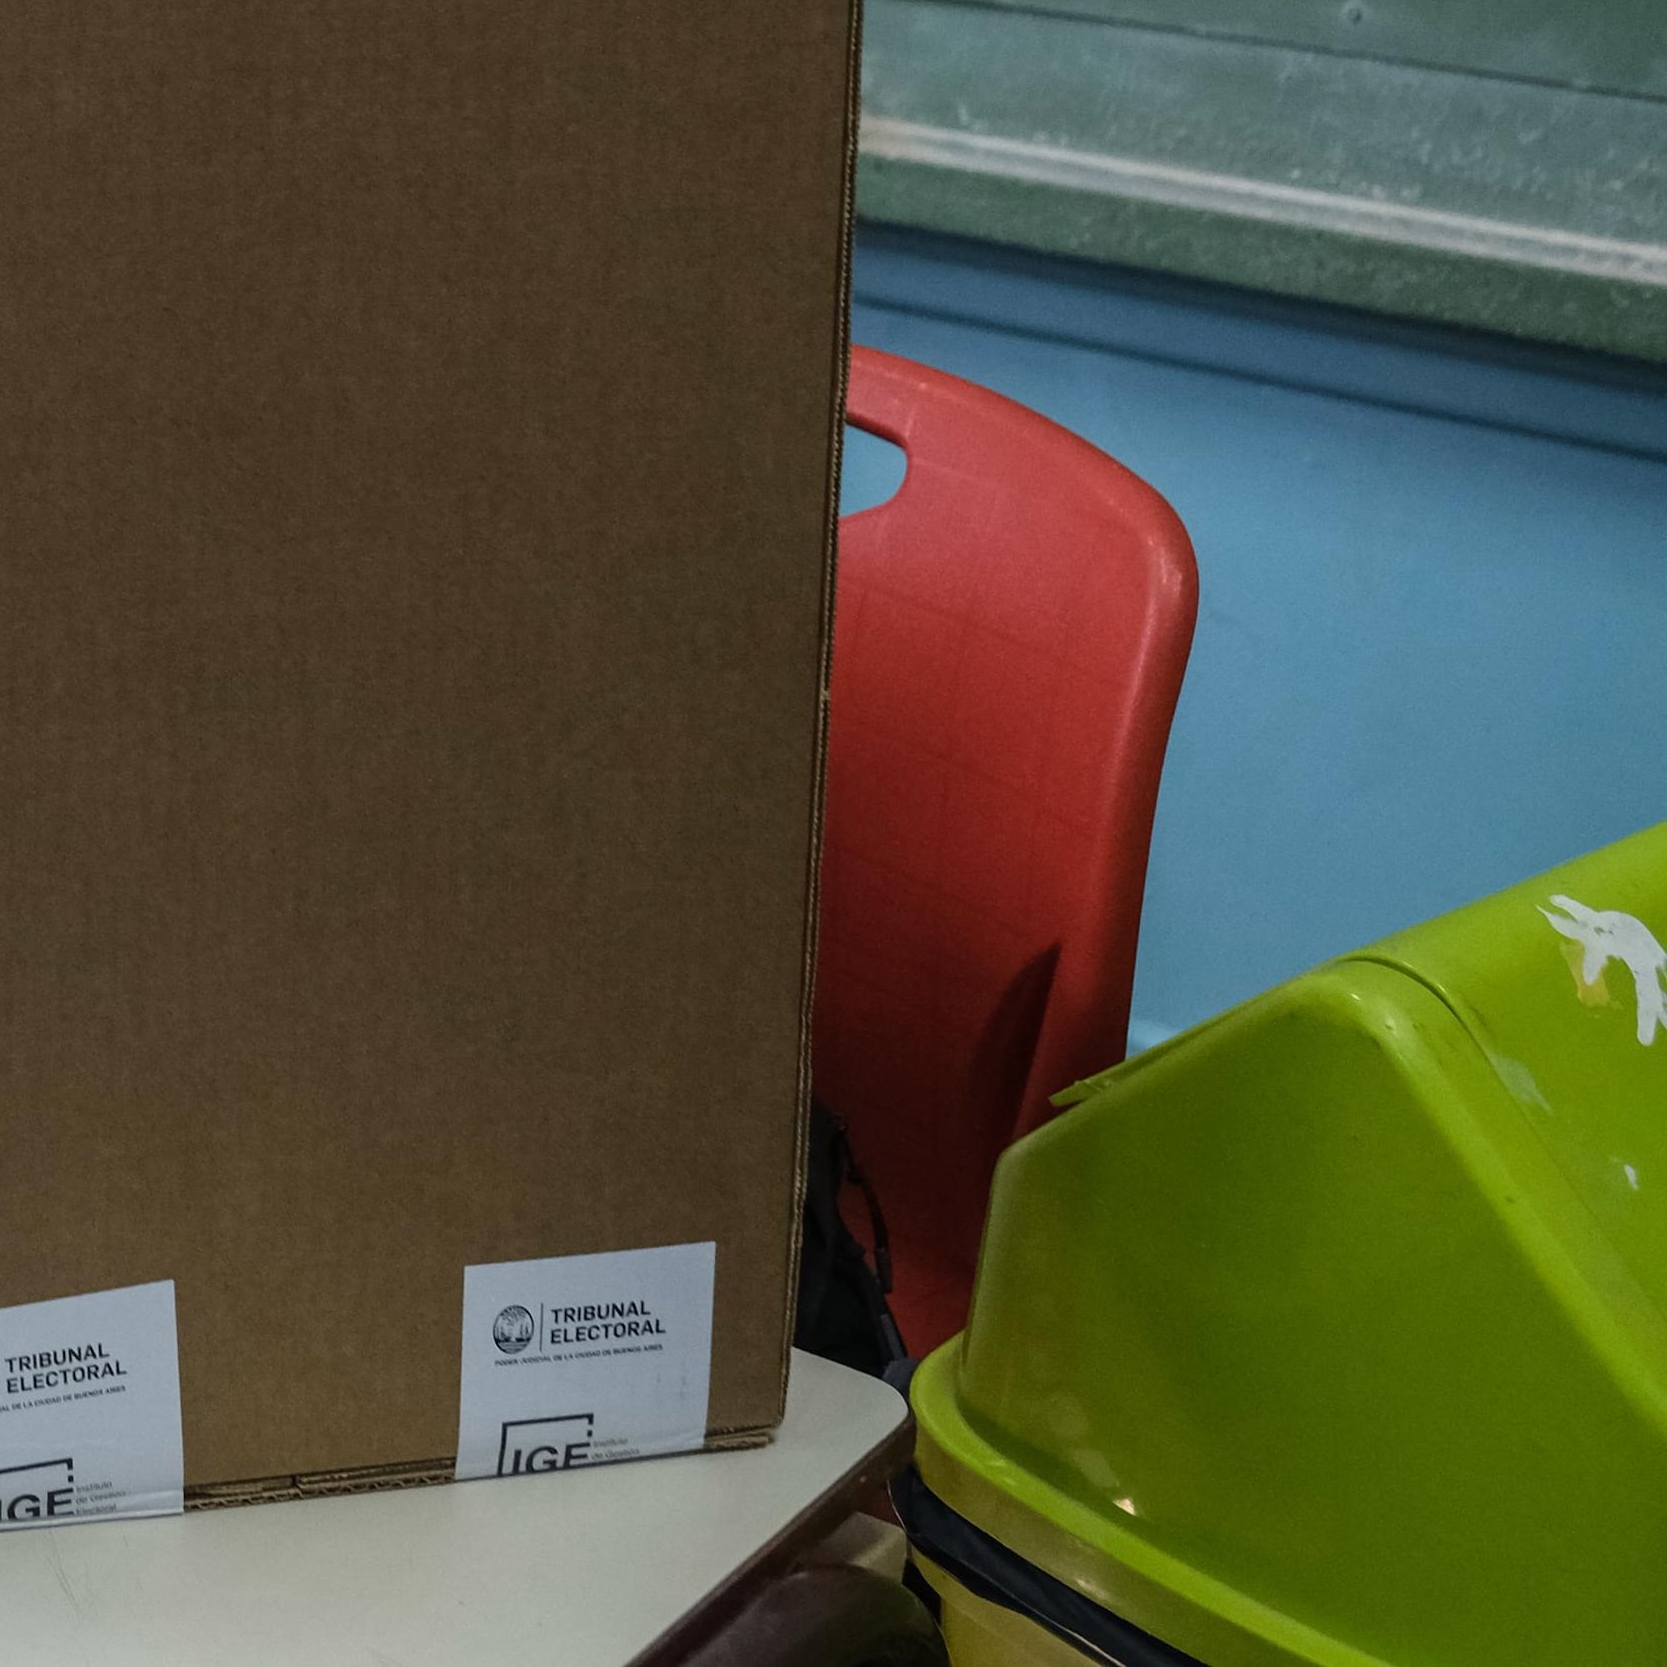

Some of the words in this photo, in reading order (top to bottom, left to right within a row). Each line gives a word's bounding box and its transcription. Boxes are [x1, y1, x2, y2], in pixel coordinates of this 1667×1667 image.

[551, 1300, 651, 1324] TRIBUNAL
[550, 1319, 666, 1345] ELECTORAL
[5, 1342, 110, 1373] TRIBUNAL
[6, 1361, 128, 1394] ELECTORAL
[513, 1441, 591, 1474] IGE
